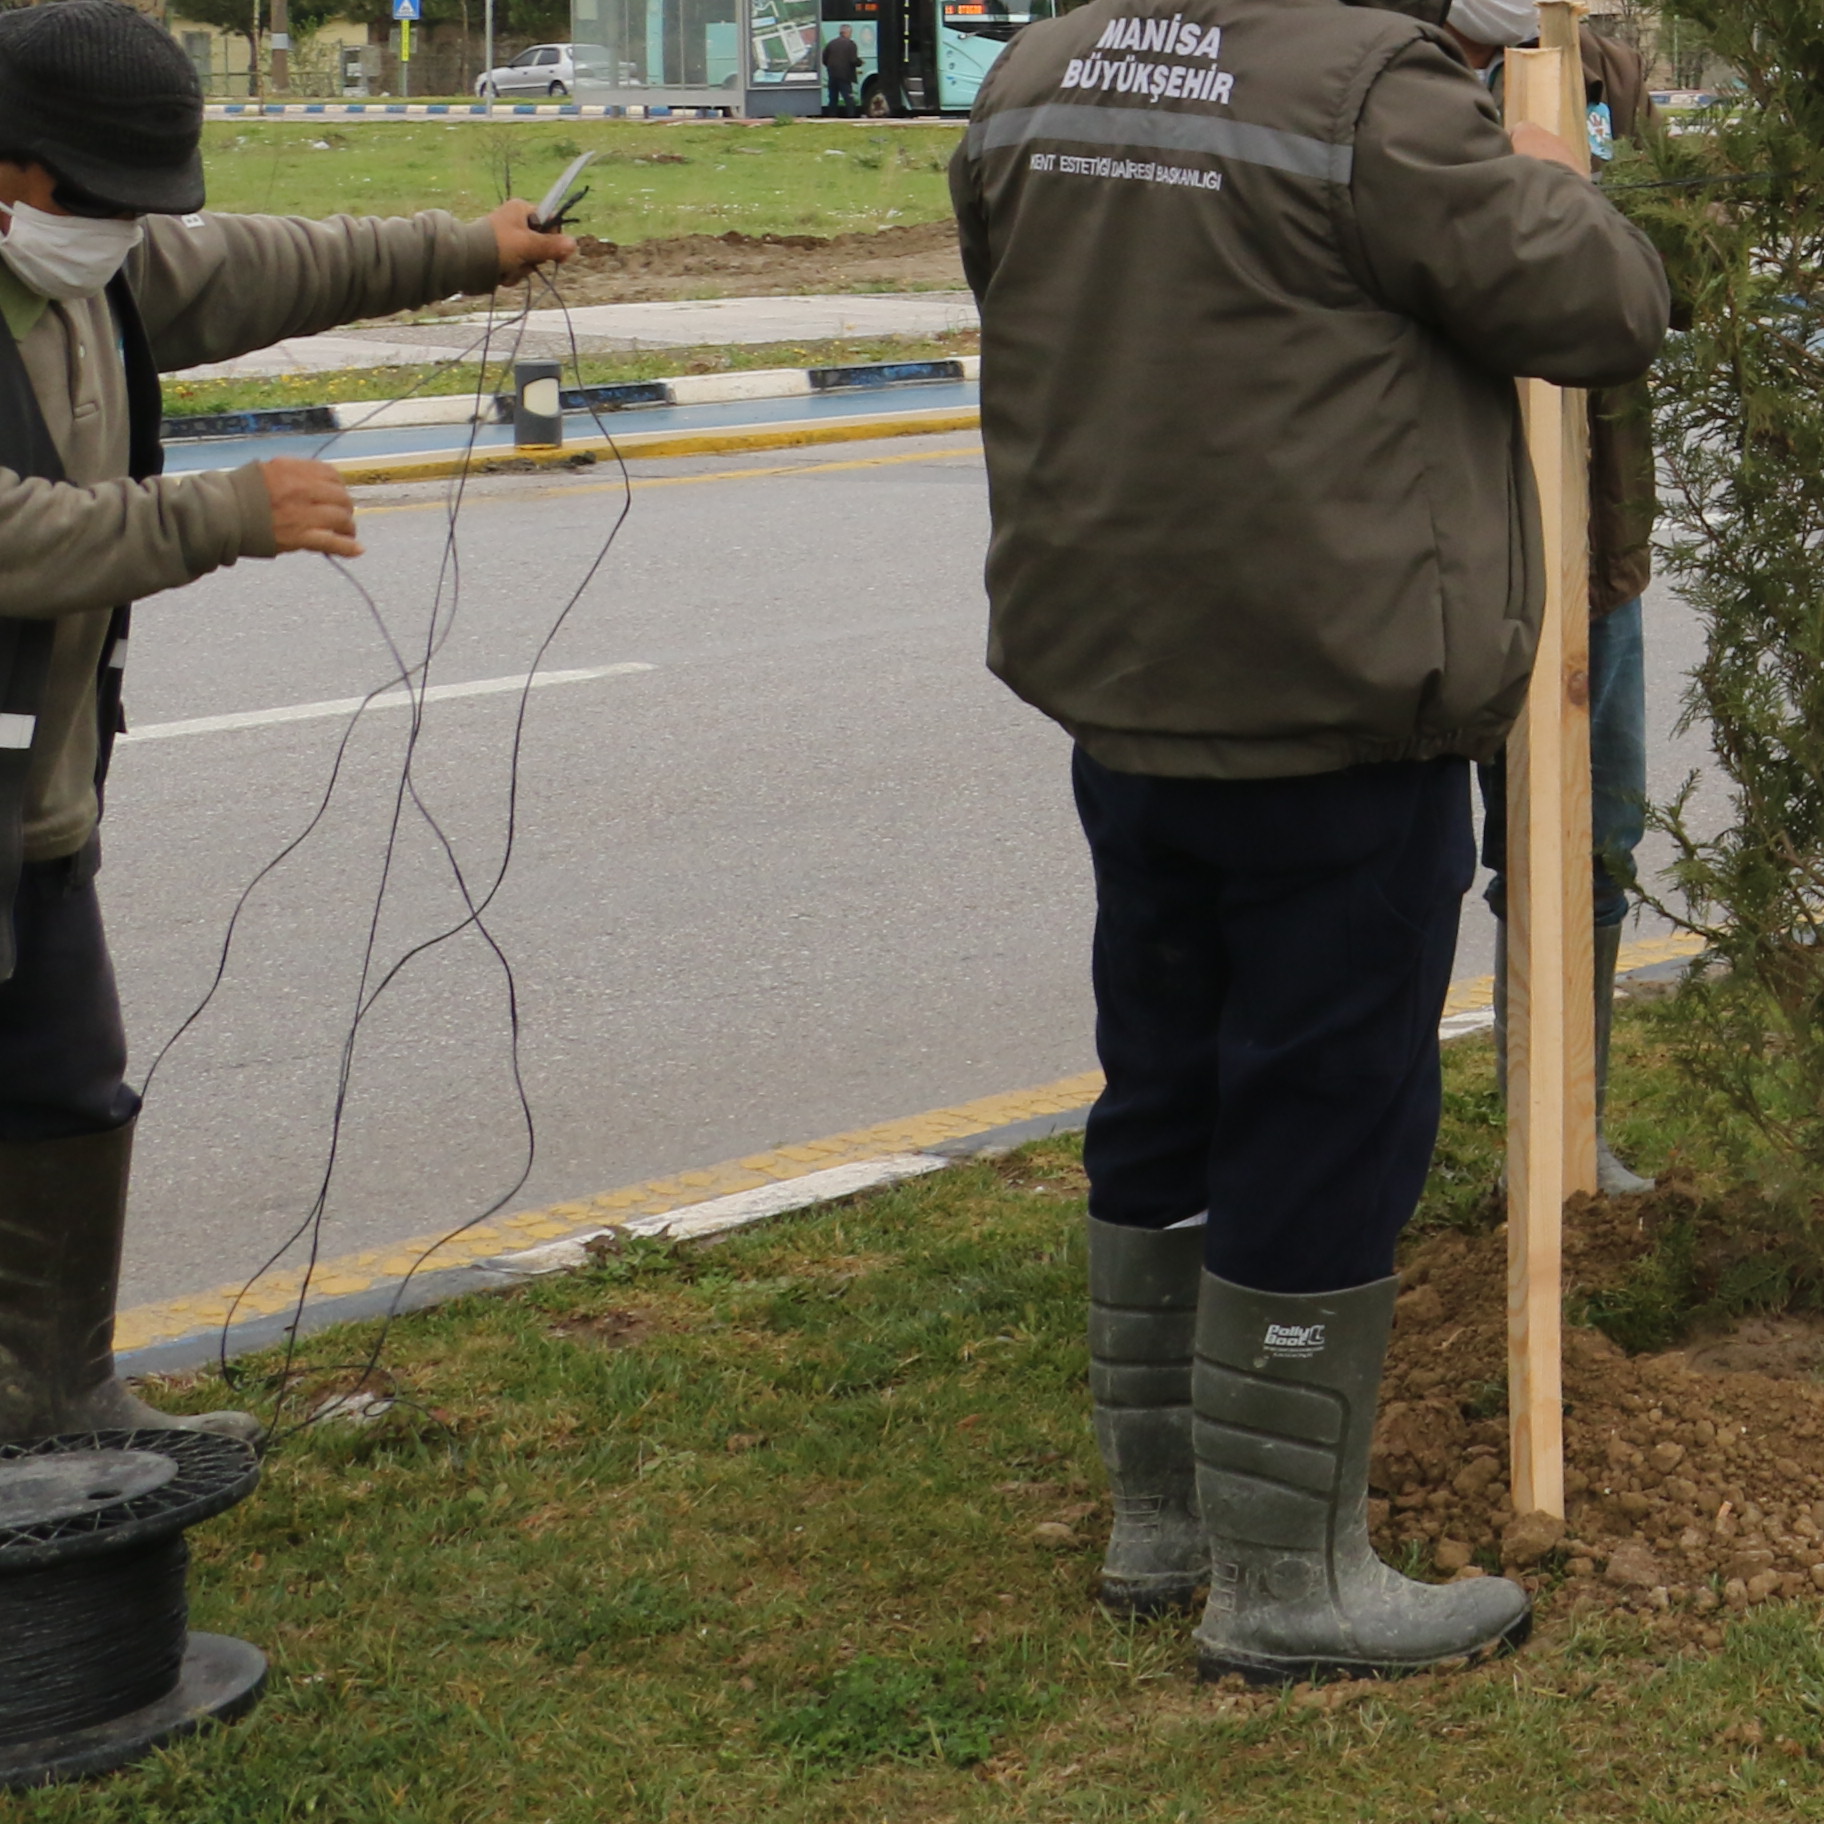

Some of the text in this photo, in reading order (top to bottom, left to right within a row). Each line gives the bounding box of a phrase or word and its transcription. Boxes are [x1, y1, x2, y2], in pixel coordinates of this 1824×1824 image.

[1095, 13, 1222, 59] MANİSA
[1060, 52, 1235, 105] BÜYÜKŞEHİR
[1029, 153, 1222, 192] KENT ESTETİĞİ DAİRESİ BAŞKANLIĞI
